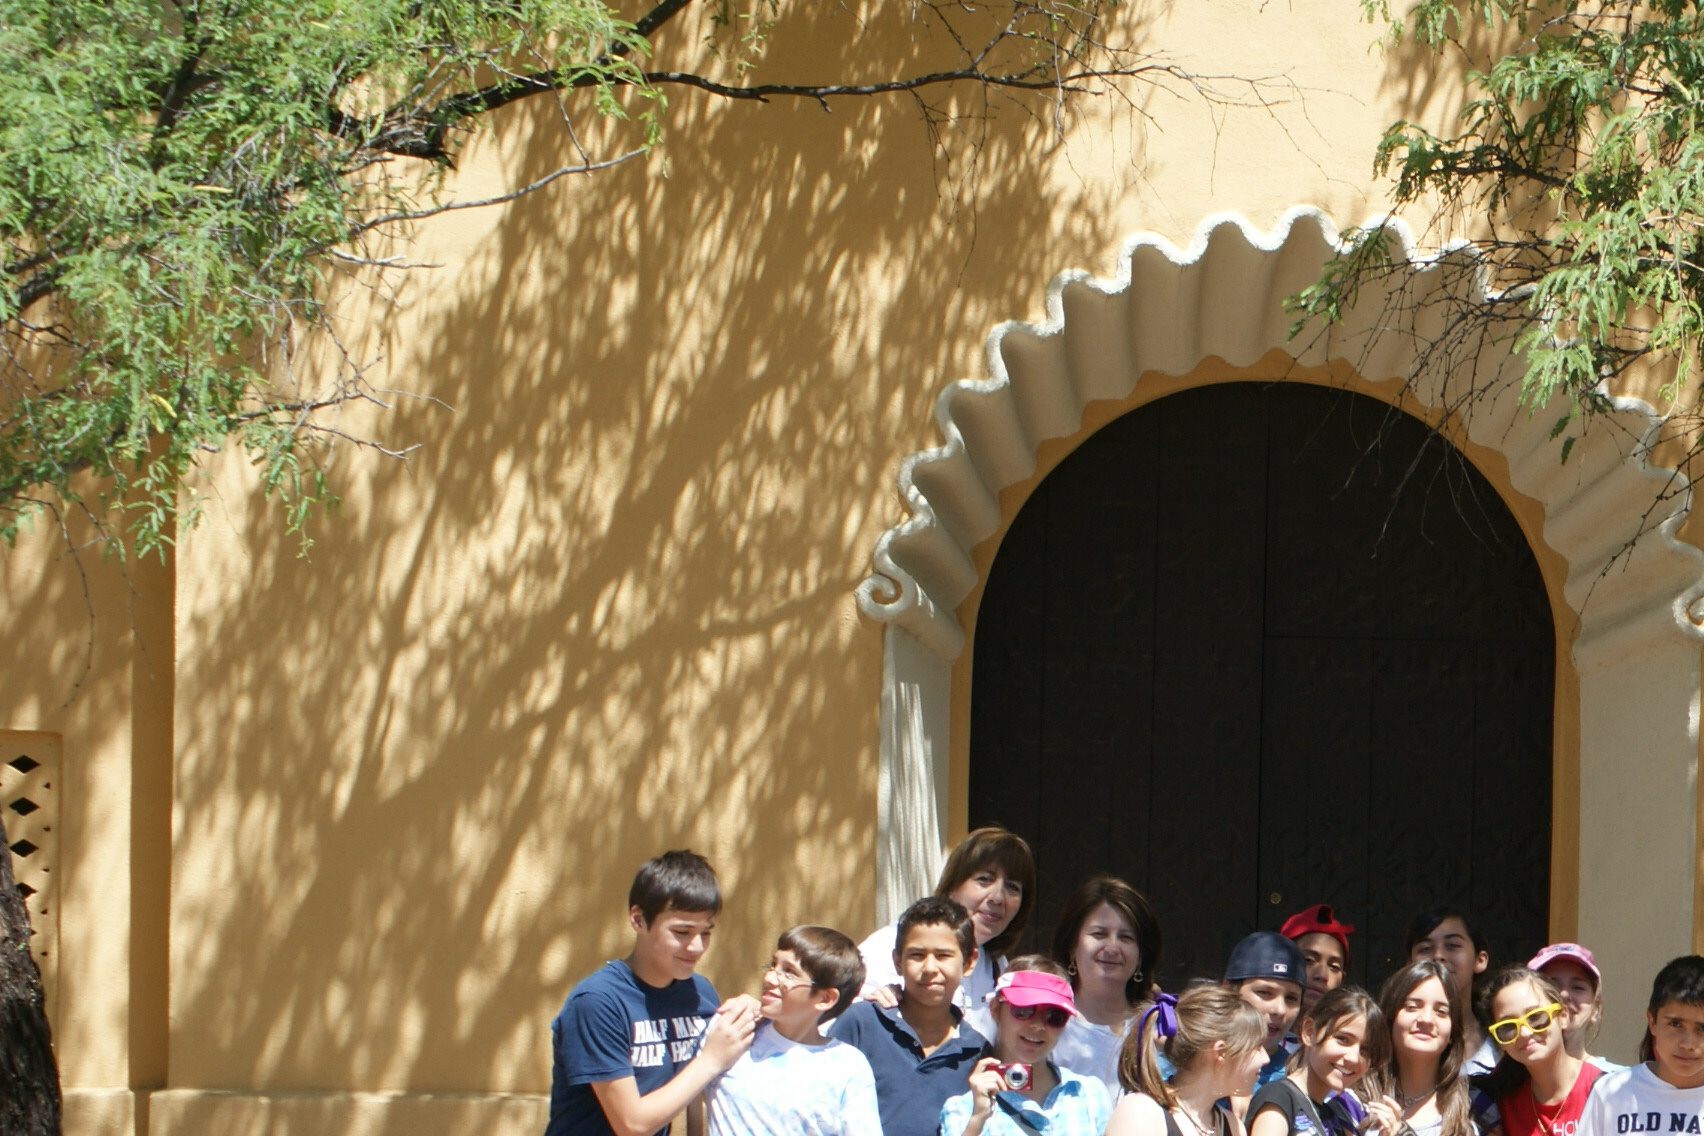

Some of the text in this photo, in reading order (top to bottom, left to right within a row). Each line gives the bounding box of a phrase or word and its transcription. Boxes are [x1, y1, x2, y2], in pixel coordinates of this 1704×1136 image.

[633, 1019, 668, 1044] HALF
[630, 1043, 666, 1068] HALF
[1617, 1112, 1661, 1134] OLD
